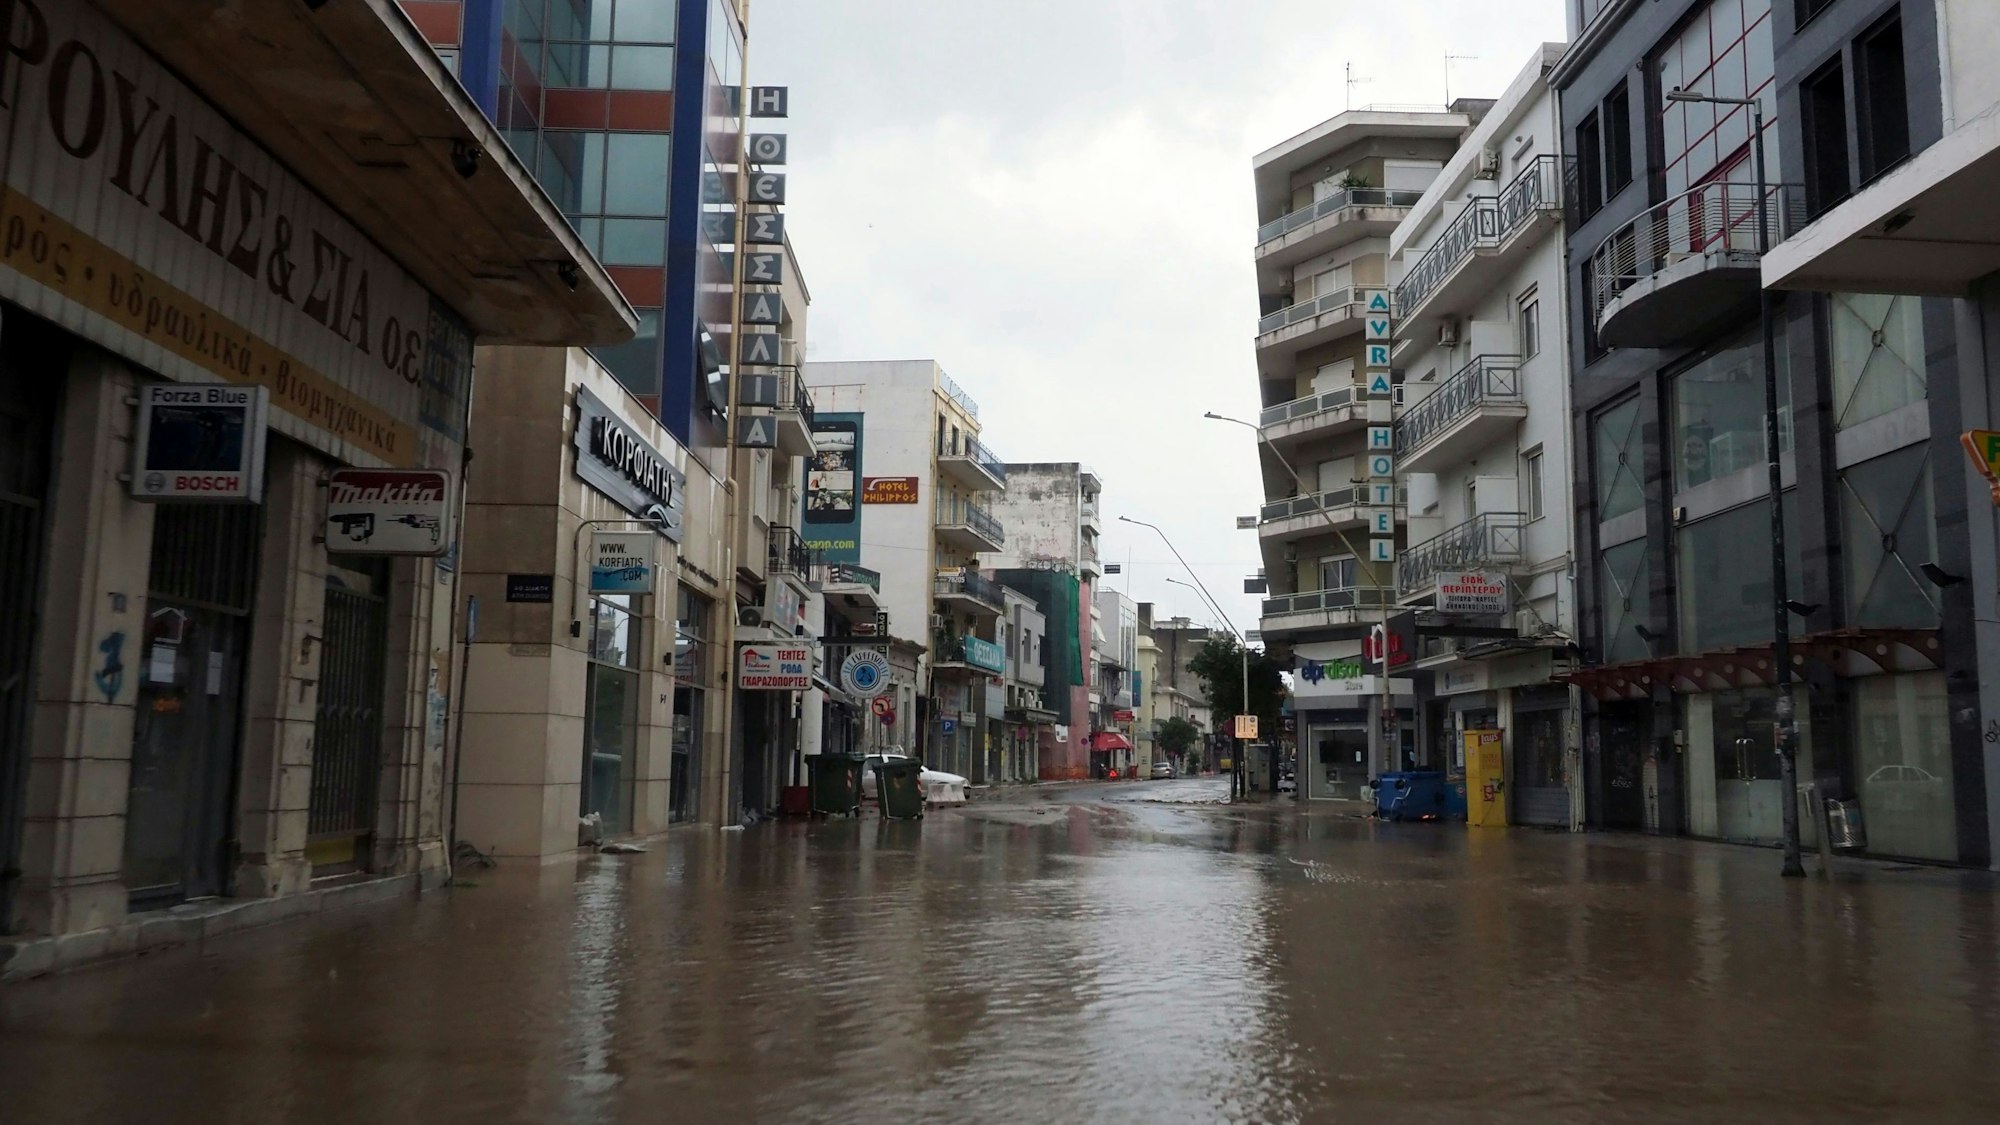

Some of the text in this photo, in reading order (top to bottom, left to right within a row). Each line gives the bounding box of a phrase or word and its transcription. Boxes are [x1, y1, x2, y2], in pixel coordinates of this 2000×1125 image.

[266, 214, 297, 304] &
[302, 228, 370, 355] ΣΙΑ
[109, 270, 252, 376] υδραυλικά
[276, 358, 397, 453] βιομηχανικά
[152, 388, 248, 404] Forza Blue
[1370, 292, 1391, 559] AVRA HOTEL
[602, 416, 676, 510] ΚΟΡΦΙΑΤΗΣ
[175, 476, 239, 491] BOSCH
[879, 482, 909, 491] HOTEL
[863, 493, 917, 502] PHILIPPOS
[600, 543, 627, 554] WWW.
[599, 557, 643, 568] KORFIATIS
[619, 570, 642, 581] .COM
[1461, 575, 1483, 584] ΕΙΔΗ
[1443, 585, 1502, 594] ΠΕΡΙΠΤΕΡΟΥ
[777, 650, 807, 661] ΤΕΝΤΕΣ
[780, 663, 803, 674] ΡΟΛΑ
[741, 676, 808, 687] ΓΚΑΡΑΖΟΠΟΡΤΕΣ
